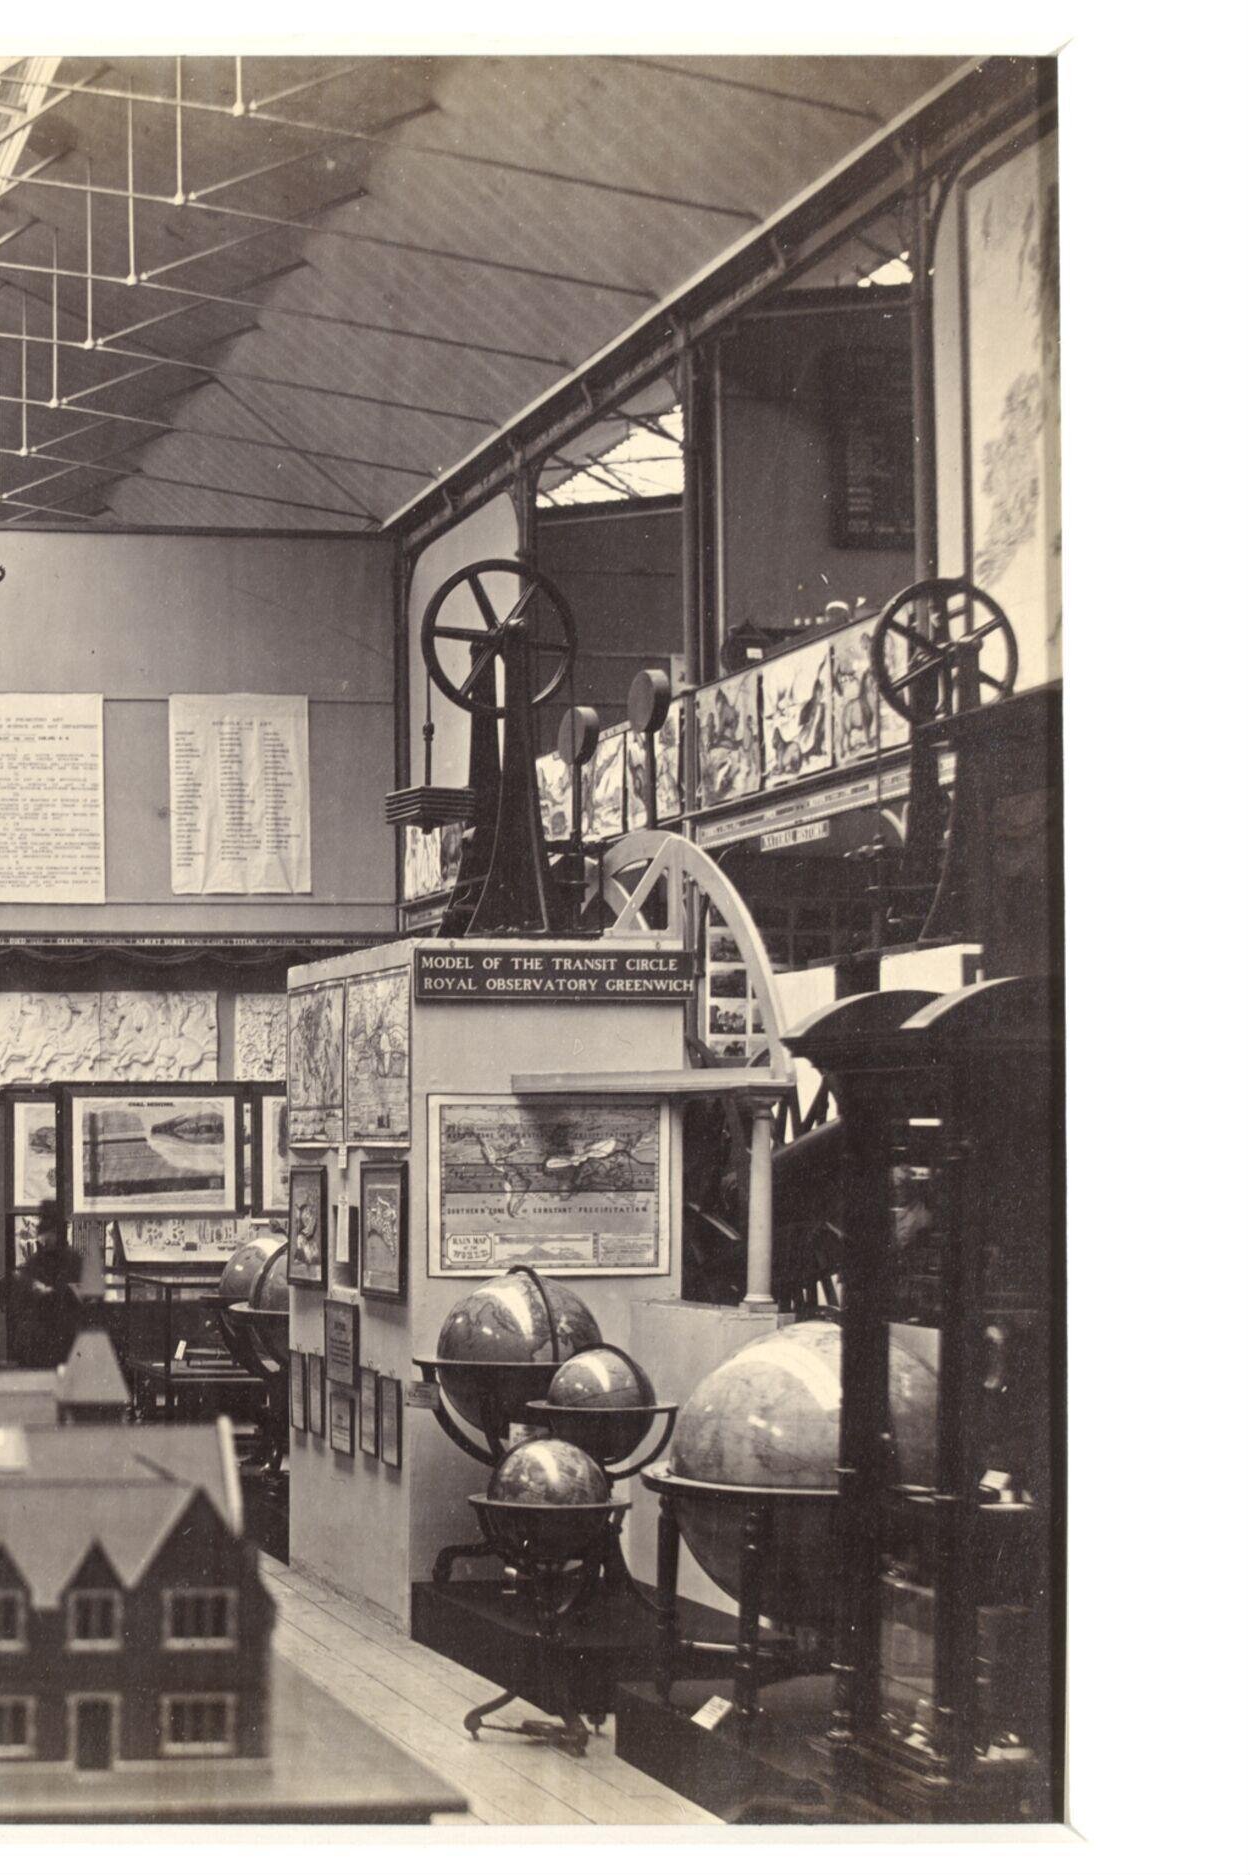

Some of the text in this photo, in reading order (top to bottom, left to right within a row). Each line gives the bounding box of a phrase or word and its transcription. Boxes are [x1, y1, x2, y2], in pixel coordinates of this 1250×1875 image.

[421, 956, 678, 970] MODEL OF THE TRANSIT CIRCLE
[423, 977, 694, 991] ROYAL OBSERVATORY GREENWICH
[447, 1207, 486, 1215] SOUTHERN
[578, 1205, 648, 1213] PRECIPITATION
[452, 1237, 471, 1245] RAIN
[473, 1237, 488, 1245] MAP
[454, 1250, 489, 1259] WORLD
